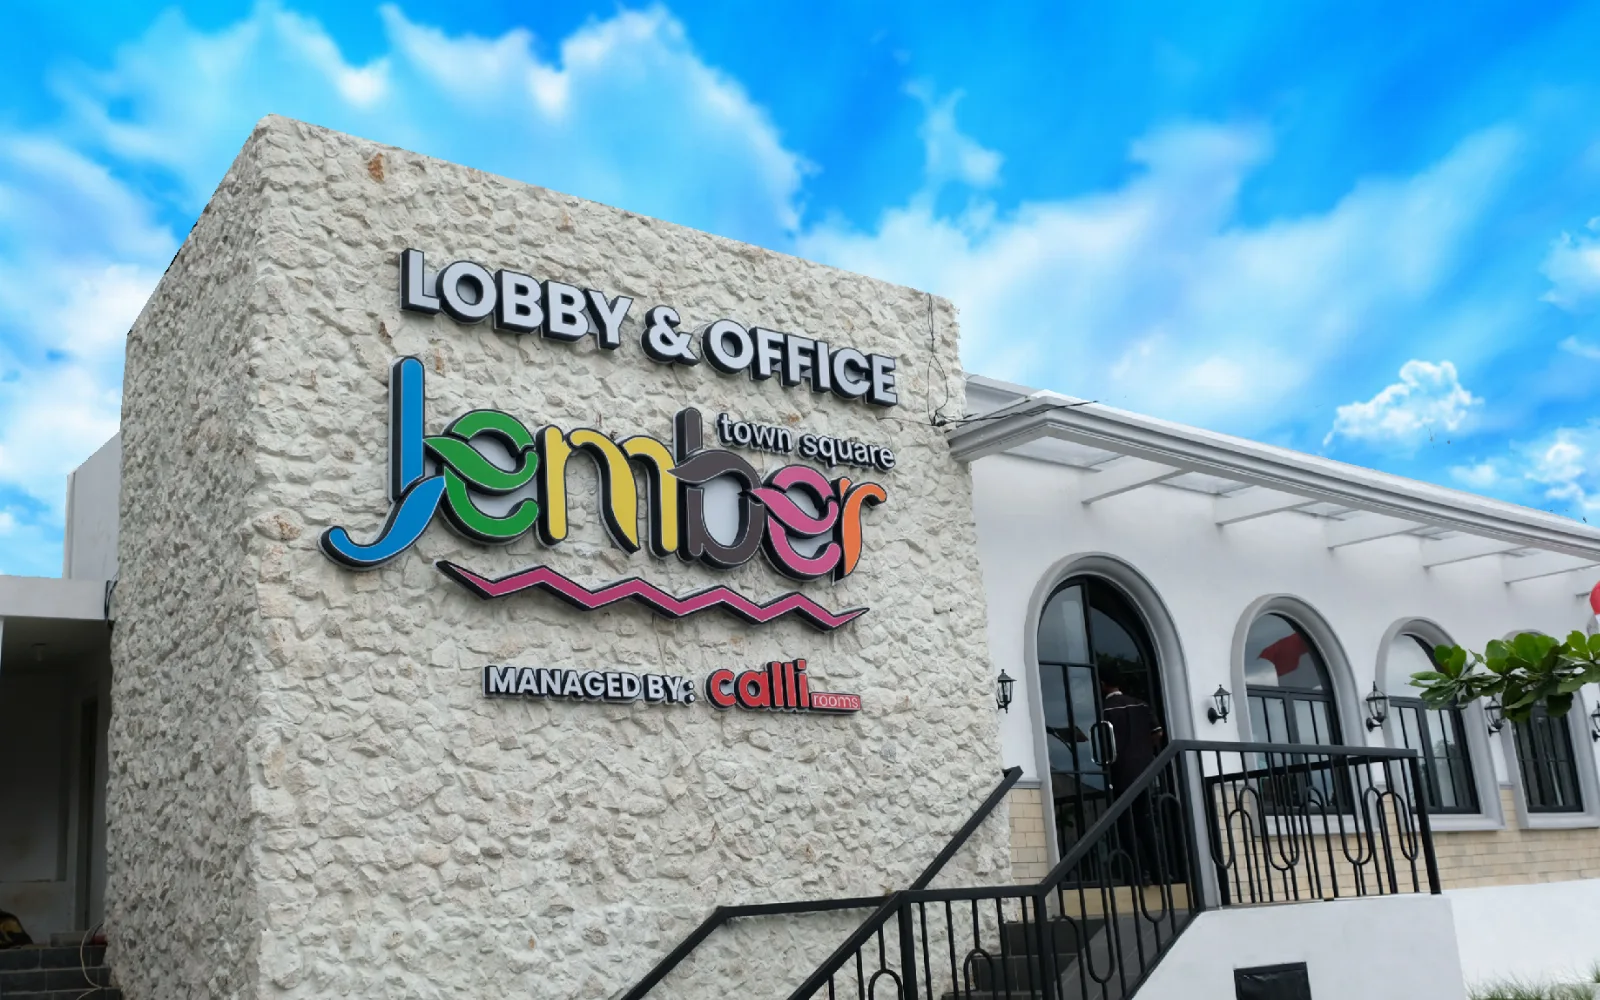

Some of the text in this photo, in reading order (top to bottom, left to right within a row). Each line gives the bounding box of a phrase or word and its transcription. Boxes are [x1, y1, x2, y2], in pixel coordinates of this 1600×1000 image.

[402, 248, 898, 407] LOBBY & OFFICE
[321, 355, 888, 584] Jember
[718, 412, 896, 471] town square
[485, 659, 861, 714] MANAGED BY: calli rooms
